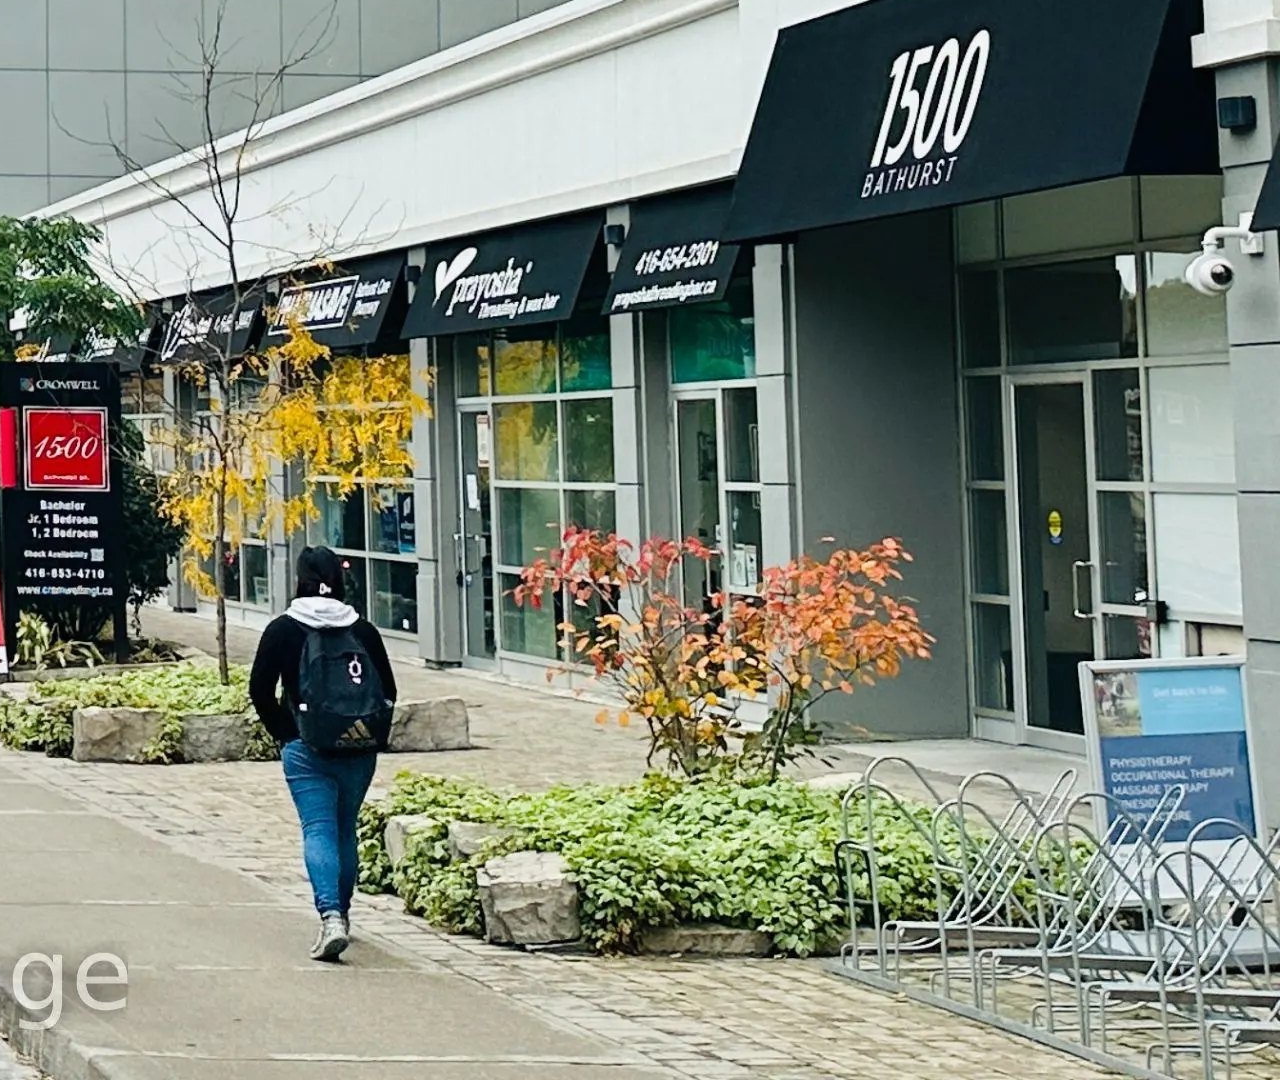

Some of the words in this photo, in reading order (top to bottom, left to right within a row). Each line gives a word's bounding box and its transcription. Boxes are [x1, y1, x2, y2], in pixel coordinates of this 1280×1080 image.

[870, 29, 990, 168] 1500
[860, 156, 959, 199] BATHURST
[635, 240, 719, 275] 416-654-2301
[445, 257, 523, 316] prayosha
[35, 380, 100, 390] CROMWELL
[34, 436, 99, 459] 1500
[40, 500, 86, 511] Bachelor
[52, 514, 98, 524] Bedroom
[43, 527, 51, 538] 2
[52, 528, 99, 538] Bedroom
[1110, 755, 1192, 768] PHYSIOTHERAPY
[1111, 769, 1188, 782] OCCUPATIONAL
[1190, 767, 1235, 780] THERAPY
[1113, 784, 1160, 796] MASSAGE
[1163, 782, 1209, 794] TRAPY
